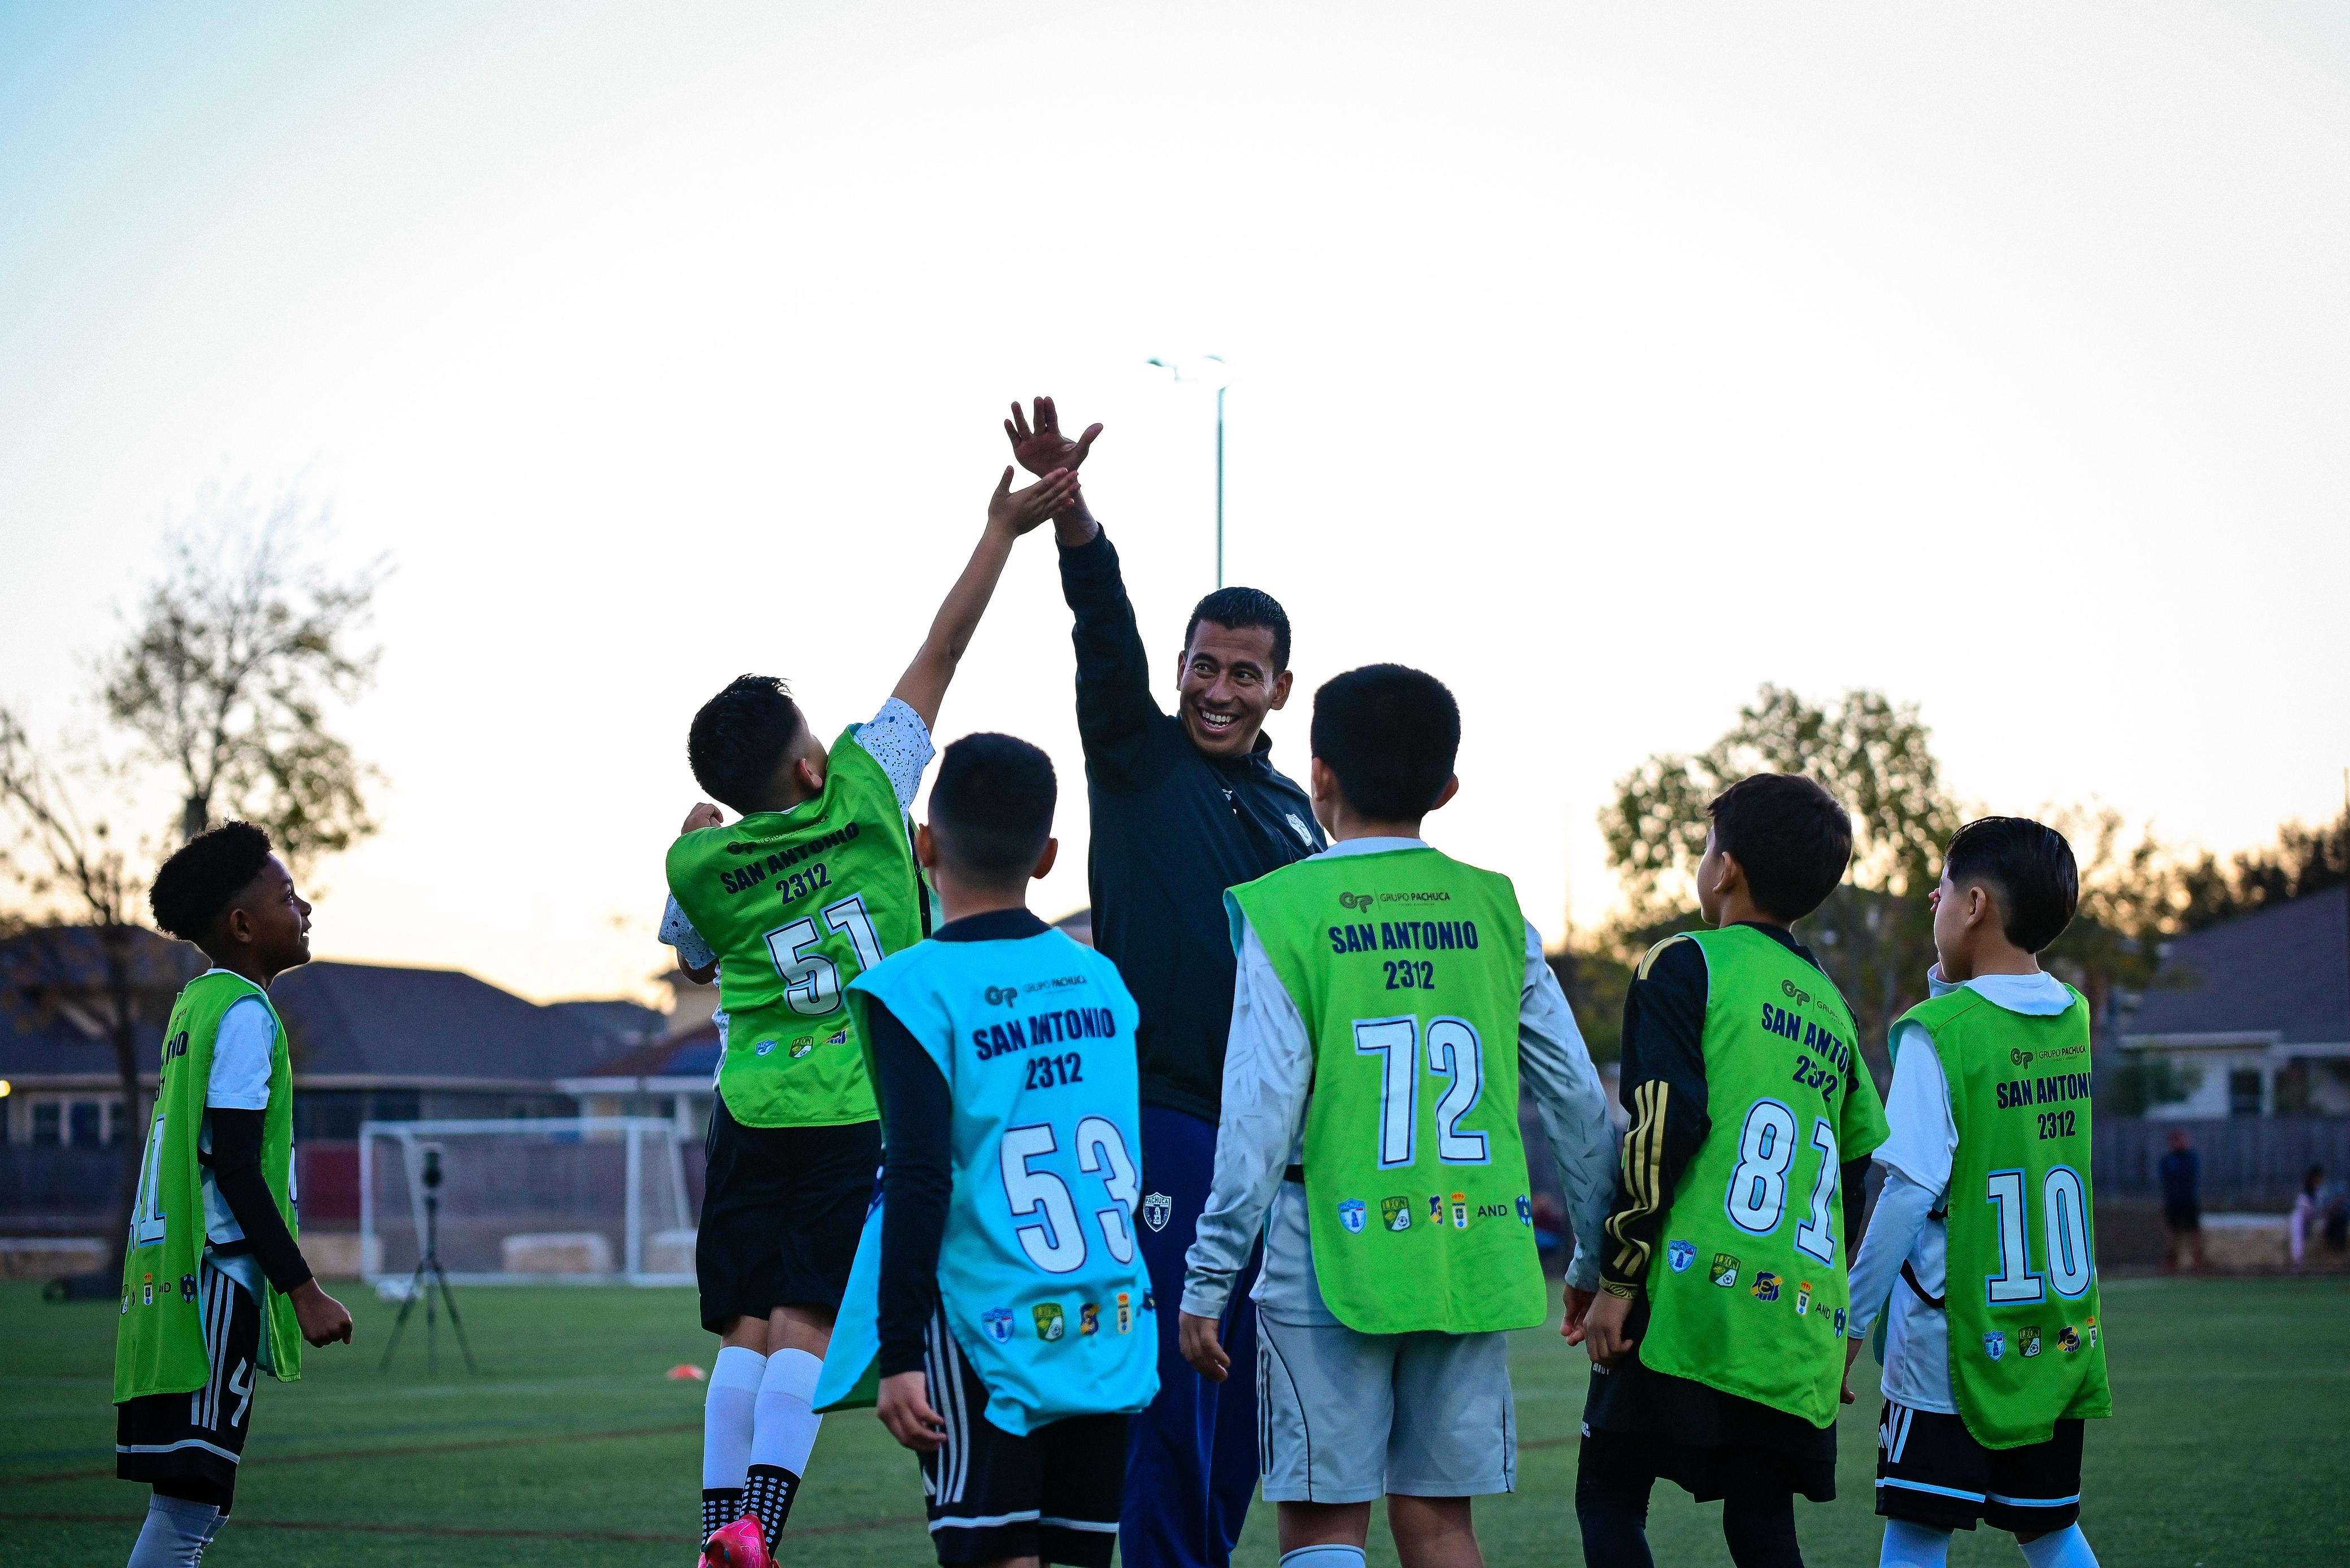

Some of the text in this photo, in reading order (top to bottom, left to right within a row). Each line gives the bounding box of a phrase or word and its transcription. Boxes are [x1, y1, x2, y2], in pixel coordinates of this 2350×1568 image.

[720, 861, 766, 894] SAN
[767, 822, 859, 876] ANTONIO
[776, 863, 832, 905] 2312
[1379, 893, 1409, 902] GRUPO
[1411, 892, 1450, 901] PACHUCA
[762, 892, 885, 1016] 51
[1328, 921, 1478, 954] SAN ANTONIO
[1383, 960, 1435, 990] 2312
[972, 1008, 1116, 1061] SAN ANTONIO
[1761, 1003, 1801, 1042] SAN
[1025, 1052, 1082, 1090] 2312
[2038, 1049, 2061, 1059] GRUPO
[2061, 1044, 2086, 1056] PACHUCA
[1352, 1014, 1491, 1170] 72
[1792, 1055, 1838, 1103] 2312
[1996, 1079, 2033, 1109] SAN
[2038, 1110, 2076, 1140] 2312
[999, 1116, 1139, 1274] 53
[1724, 1097, 1839, 1269] 81
[1477, 1204, 1508, 1217] AND
[1986, 1164, 2091, 1306] 10
[1815, 1302, 1831, 1319] AND
